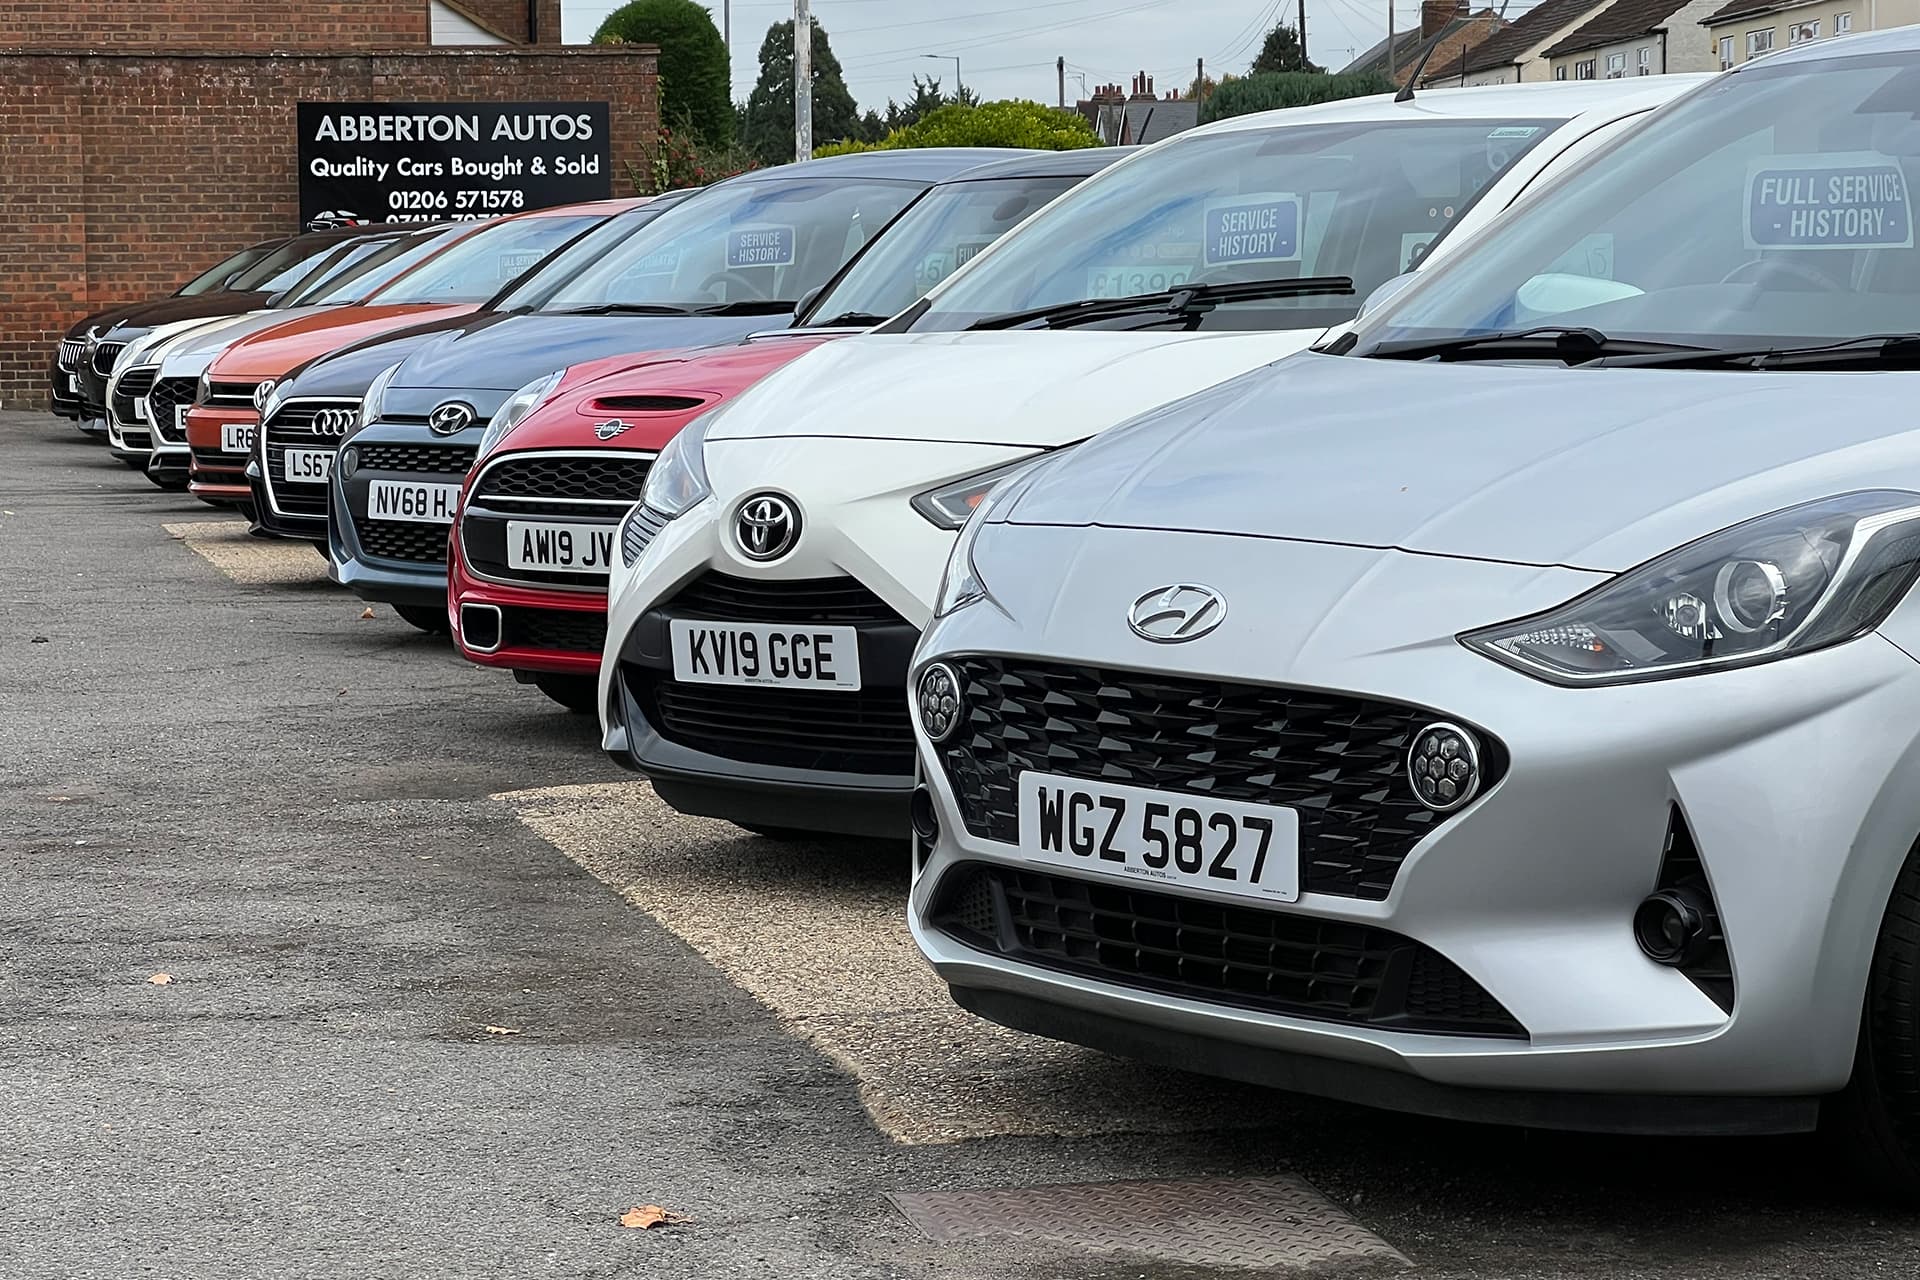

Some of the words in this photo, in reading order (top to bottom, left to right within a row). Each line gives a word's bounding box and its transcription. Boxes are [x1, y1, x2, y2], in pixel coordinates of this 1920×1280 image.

[315, 115, 479, 142] ABBERTON
[491, 114, 593, 141] AUTOS
[310, 156, 389, 181] Quality
[397, 158, 443, 176] Cars
[451, 155, 523, 180] Bought
[531, 158, 546, 175] &
[555, 155, 599, 175] Sold
[389, 191, 448, 209] 01206
[455, 190, 524, 208] 571578
[1760, 177, 1820, 205] FULL
[1828, 174, 1902, 204] SERVICE
[1221, 208, 1278, 233] SERVICE
[1790, 208, 1884, 237] HISTORY
[740, 232, 780, 247] SERVICE
[1219, 231, 1277, 257] HISTORY
[739, 247, 780, 262] HISTORY
[227, 428, 254, 448] LR6
[293, 453, 333, 477] LS67
[377, 486, 428, 516] NV68
[434, 489, 461, 518] HJ
[522, 529, 573, 565] AW19
[582, 532, 613, 567] JV
[689, 629, 760, 677] KV19
[768, 633, 836, 681] GGE
[1038, 786, 1126, 863] WGZ
[1142, 802, 1273, 884] 5827
